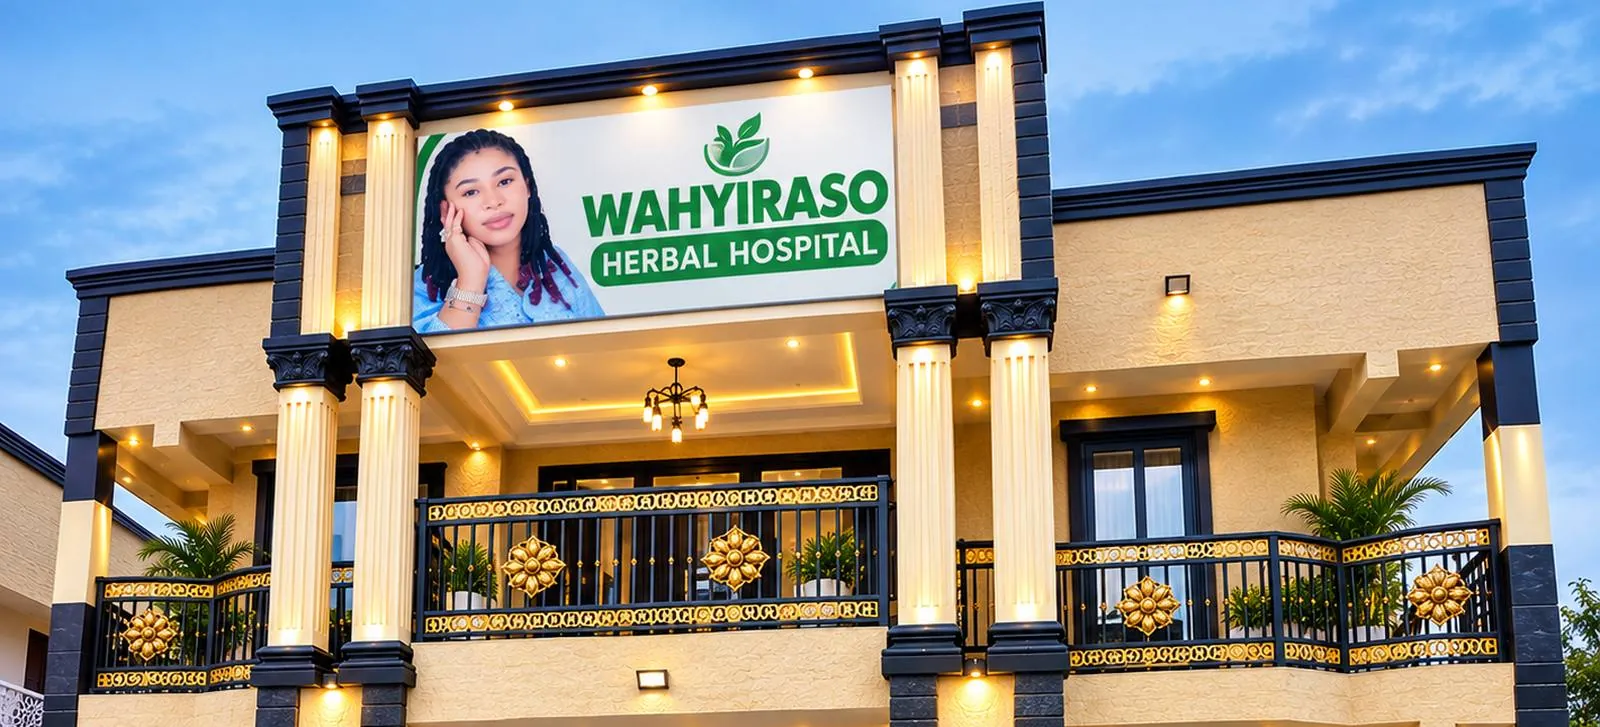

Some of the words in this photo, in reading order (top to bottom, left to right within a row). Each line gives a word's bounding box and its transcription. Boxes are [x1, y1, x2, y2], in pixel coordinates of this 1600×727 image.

[582, 169, 889, 237] WAHYIRASO
[602, 244, 718, 277] HERBAL
[730, 231, 878, 266] HOSPITAL
